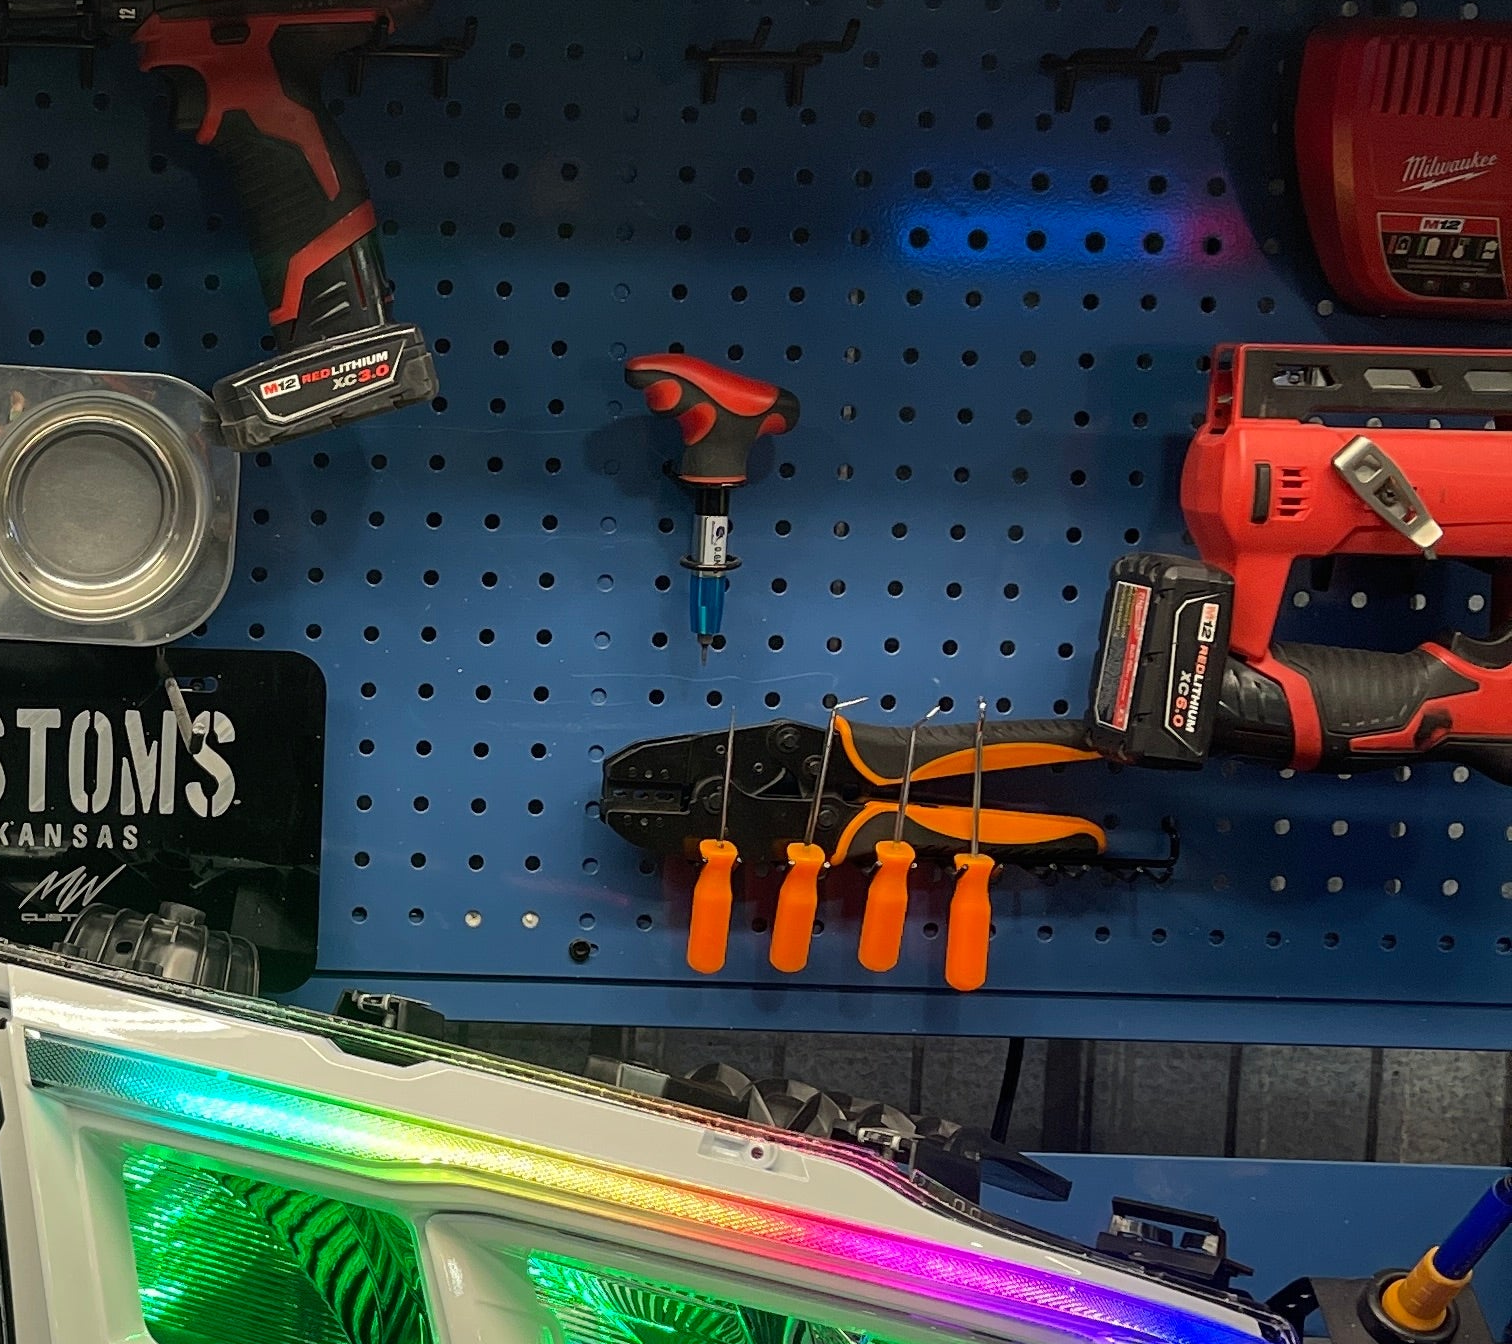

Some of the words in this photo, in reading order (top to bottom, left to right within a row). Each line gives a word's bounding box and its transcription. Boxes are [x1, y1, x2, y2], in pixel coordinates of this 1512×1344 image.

[119, 7, 136, 20] 12
[1402, 151, 1498, 182] Milwaukee
[1423, 219, 1462, 231] M12
[263, 377, 298, 396] M12
[301, 350, 389, 384] REDLITHIUM
[1201, 606, 1218, 640] M12
[1184, 643, 1210, 734] REDLITHIUM
[17, 863, 127, 913] MW
[20, 912, 78, 922] CUST
